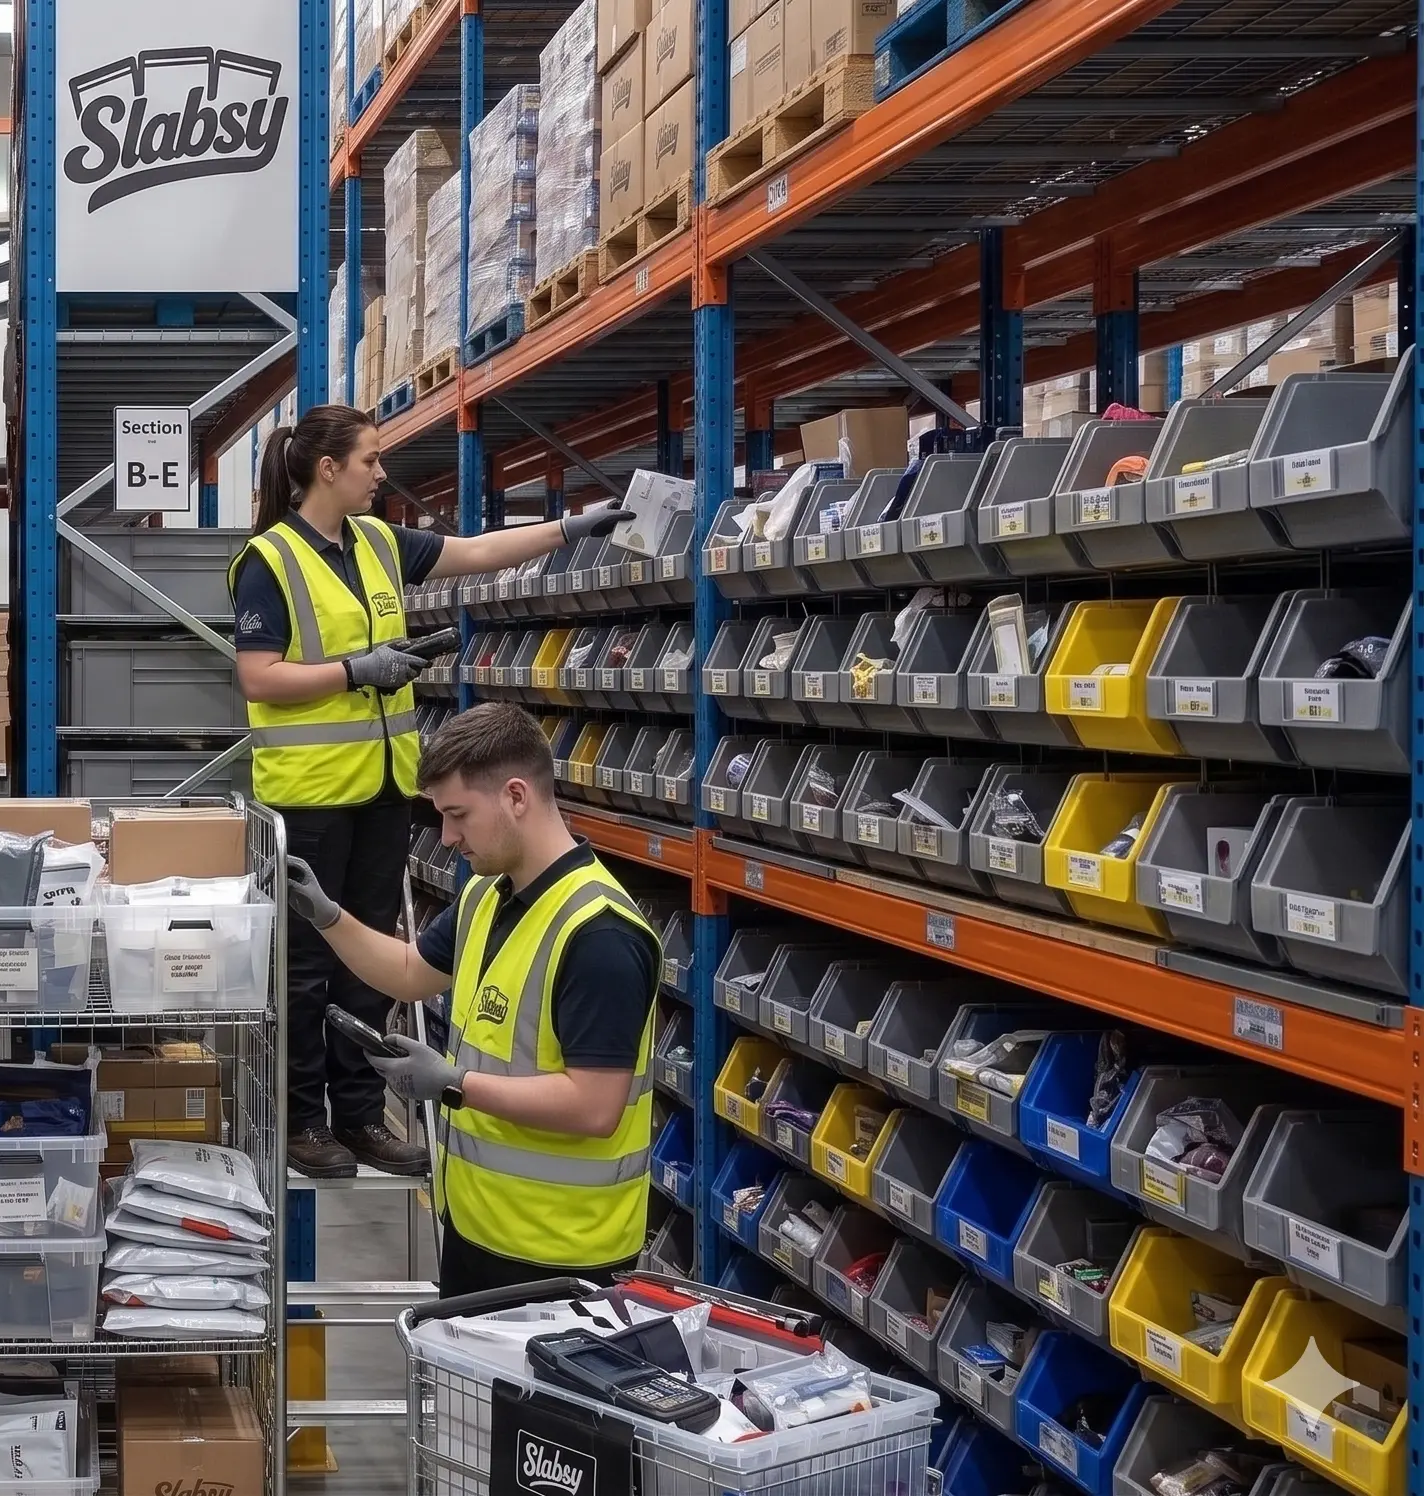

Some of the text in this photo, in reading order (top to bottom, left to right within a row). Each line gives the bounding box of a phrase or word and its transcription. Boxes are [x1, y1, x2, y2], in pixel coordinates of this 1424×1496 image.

[63, 86, 290, 214] Slabsy
[121, 420, 183, 435] Section
[127, 461, 180, 488] B-E
[522, 1441, 584, 1496] Slabsy
